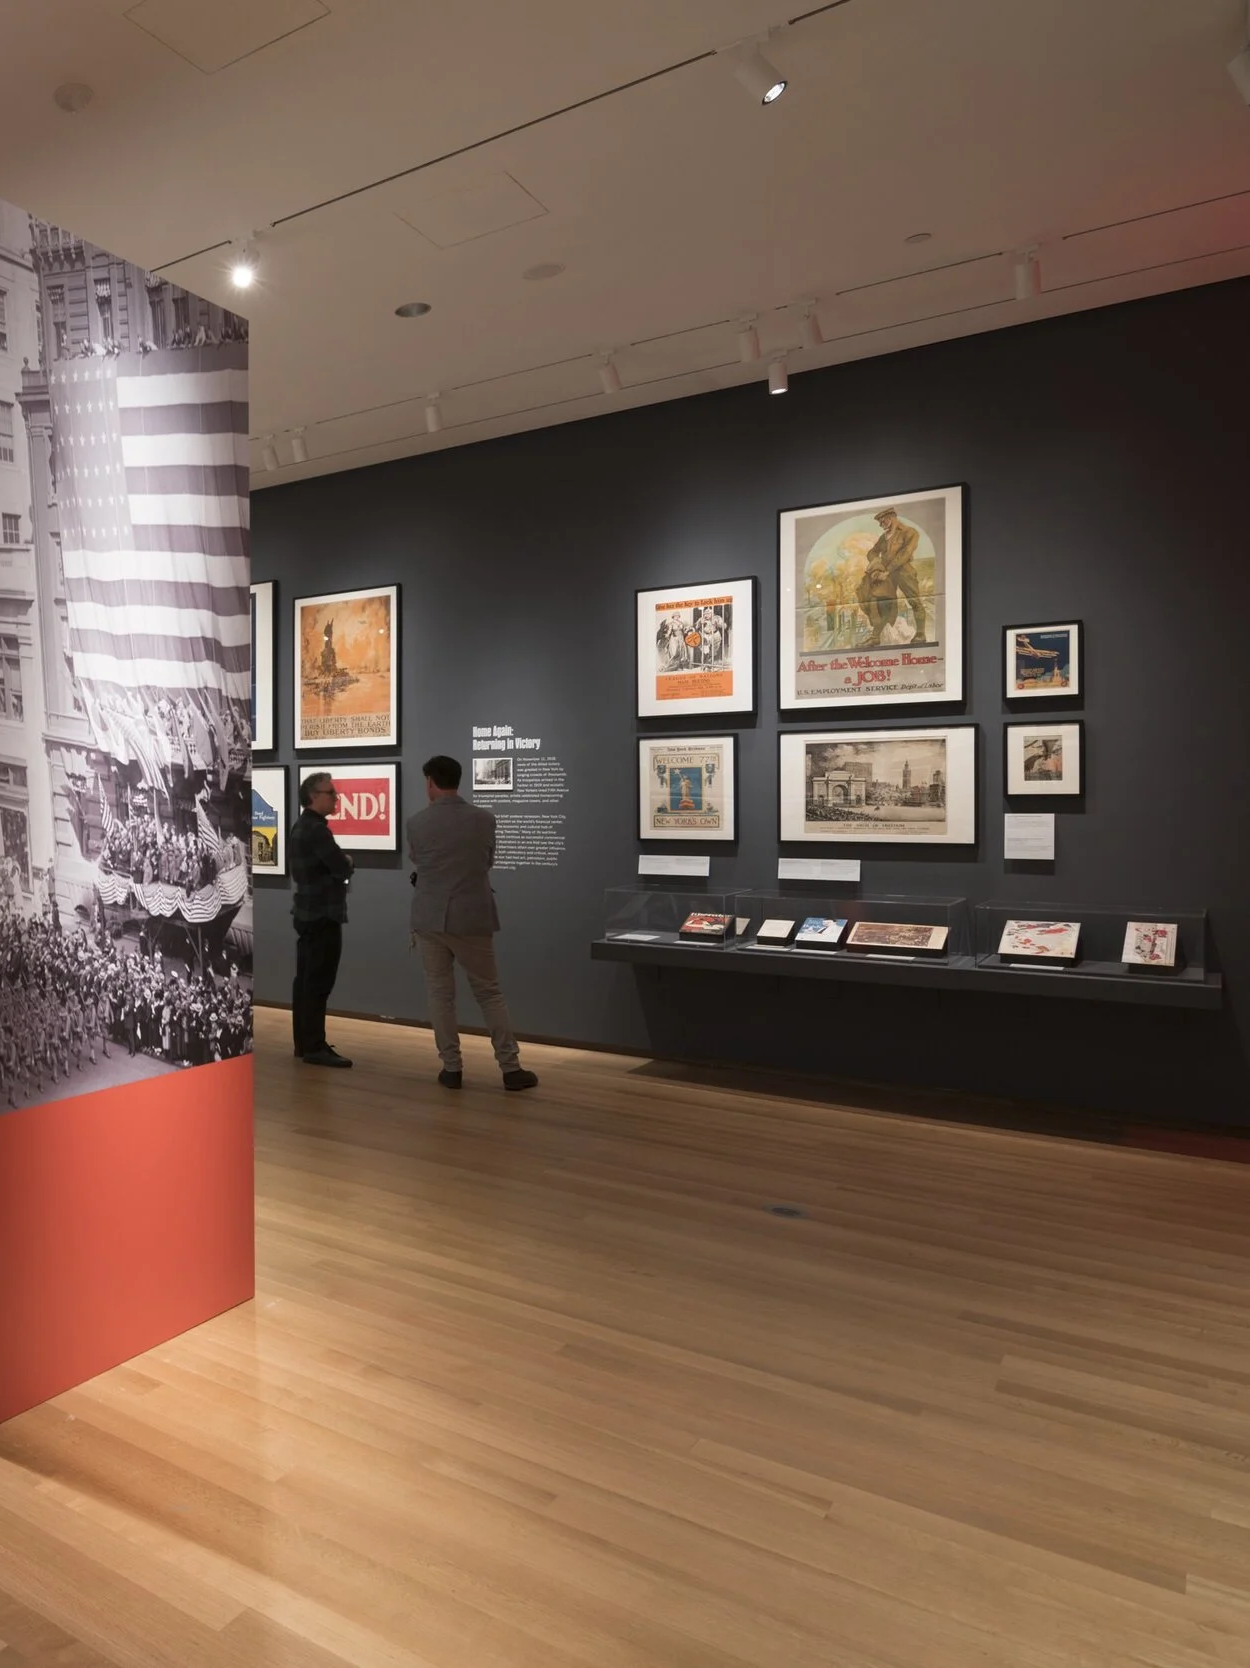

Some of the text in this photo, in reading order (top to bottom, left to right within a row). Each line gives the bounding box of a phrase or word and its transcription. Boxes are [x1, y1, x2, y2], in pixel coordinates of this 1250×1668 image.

[797, 660, 828, 672] After
[830, 658, 848, 670] the
[847, 656, 900, 669] Welcome
[852, 670, 891, 686] JOB!
[473, 725, 514, 738] Home Again:
[473, 739, 505, 751] Returning
[515, 737, 541, 750] Victory
